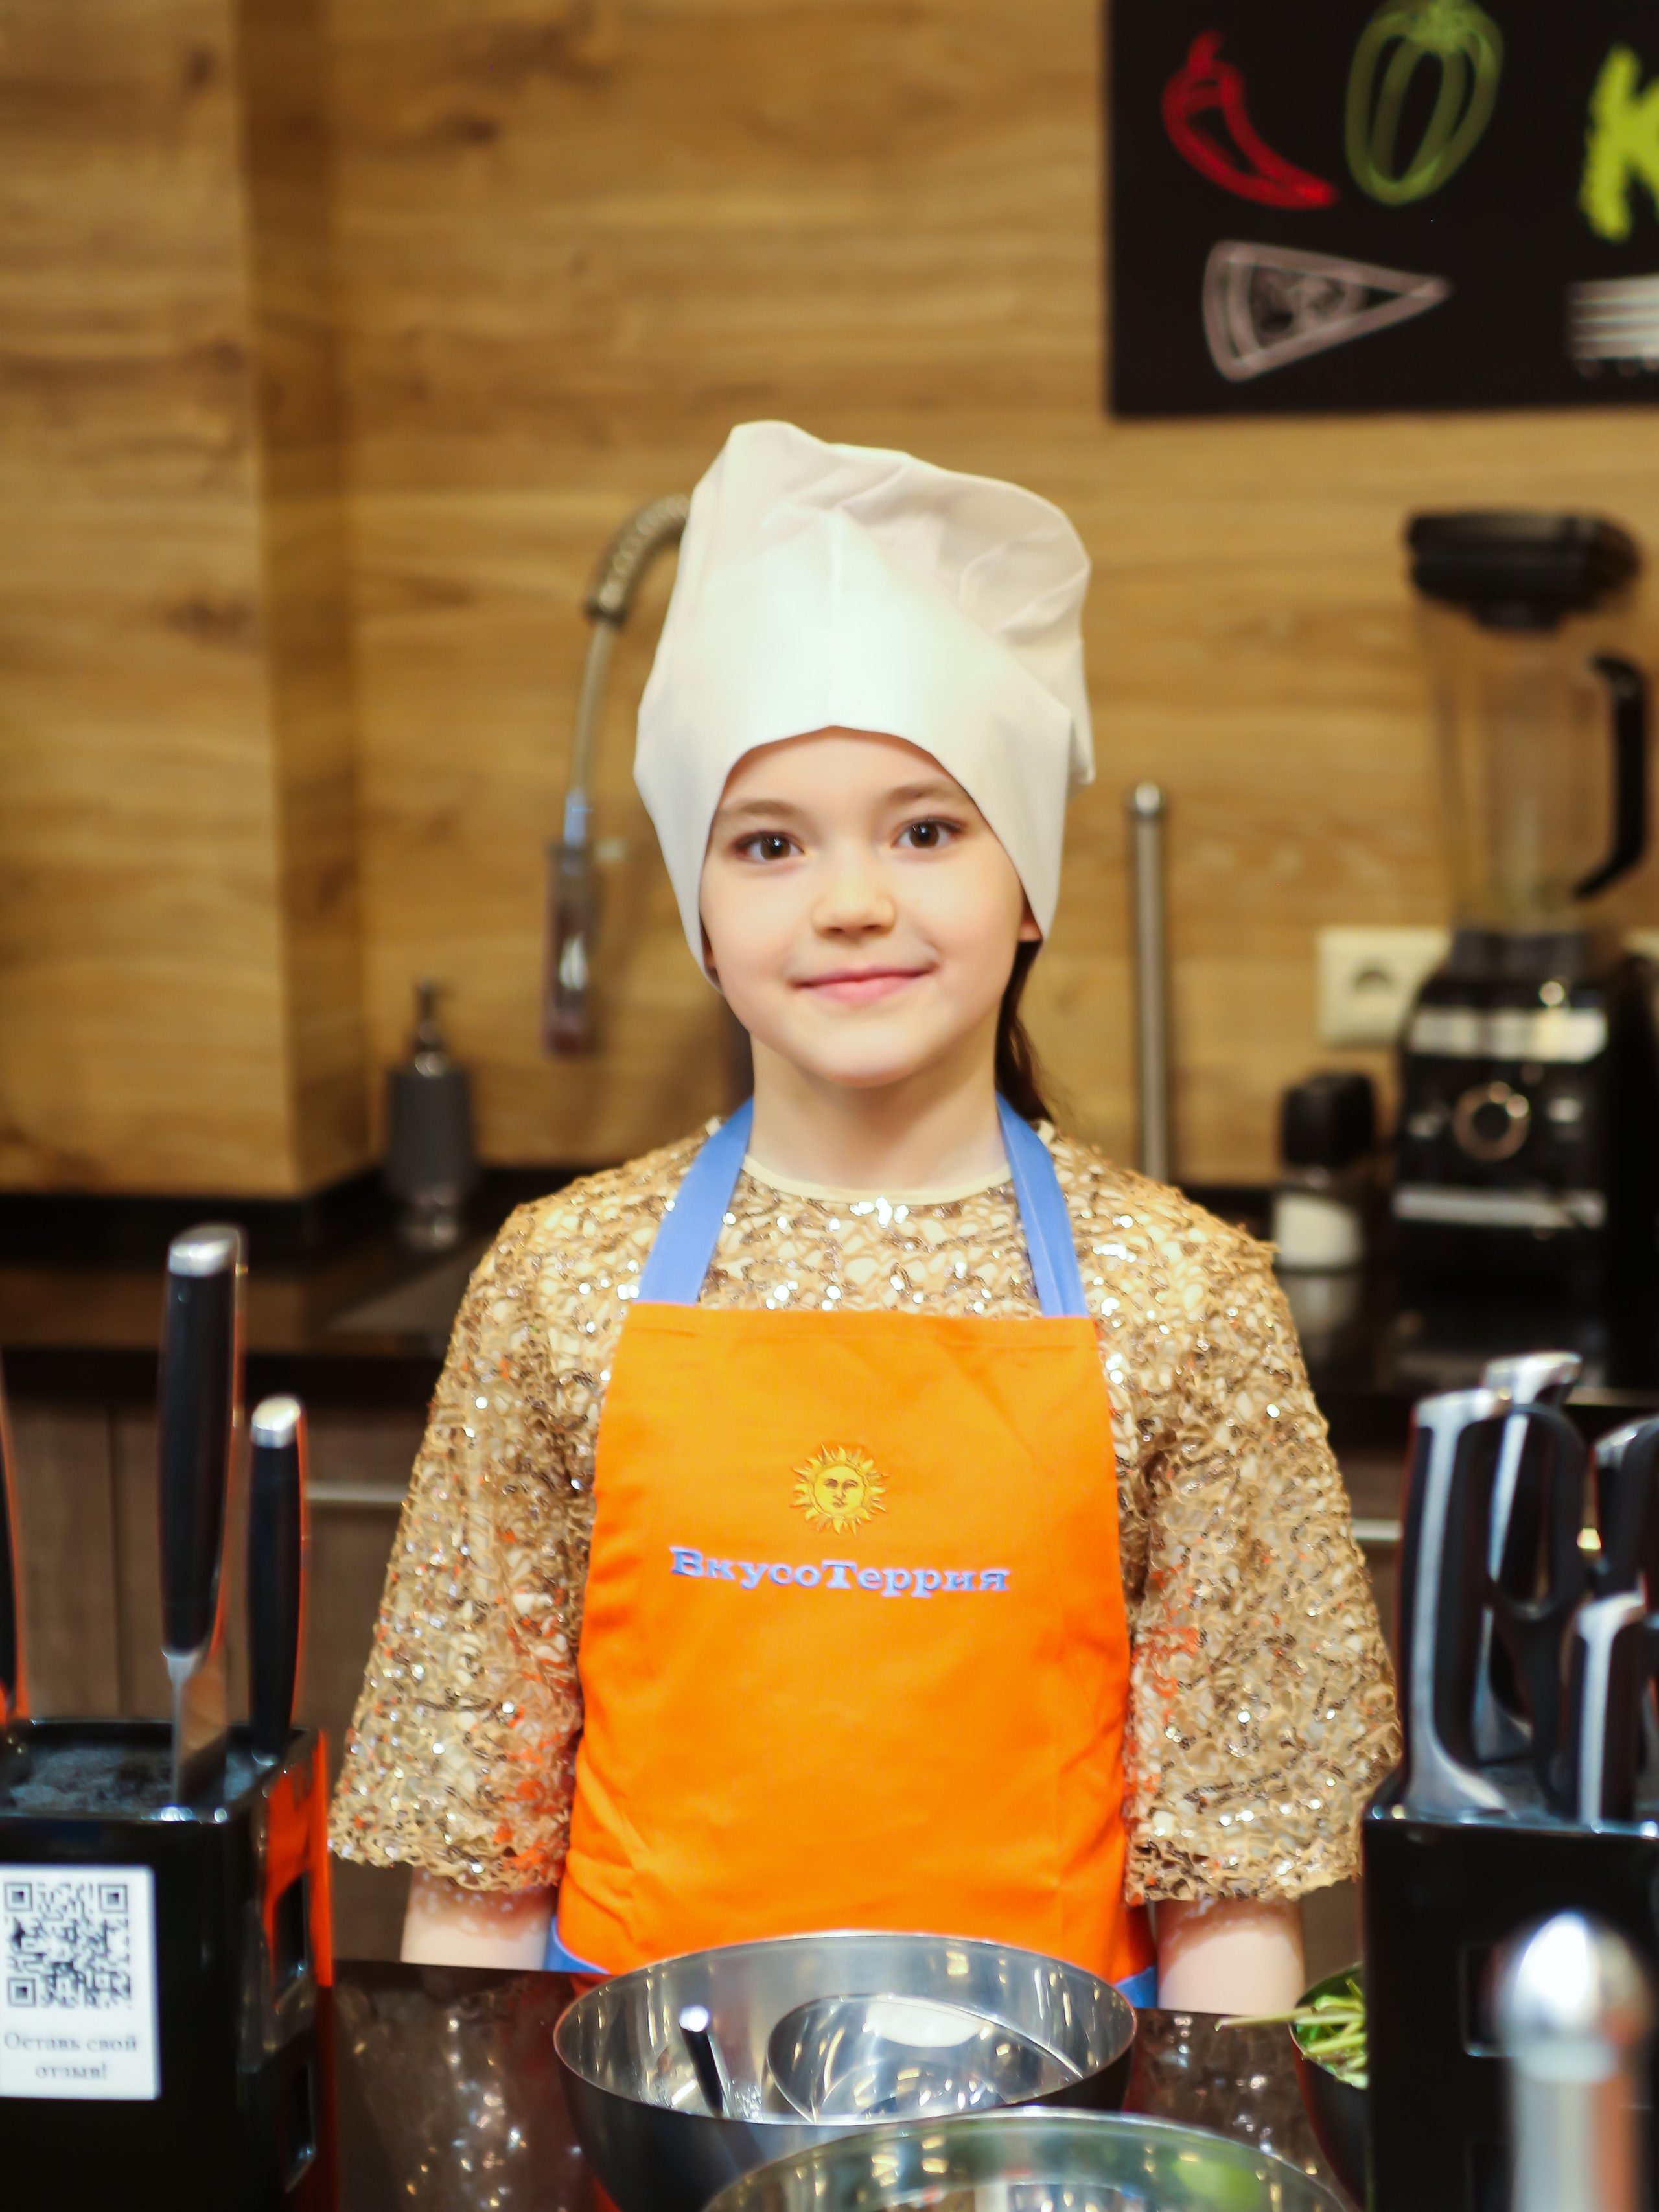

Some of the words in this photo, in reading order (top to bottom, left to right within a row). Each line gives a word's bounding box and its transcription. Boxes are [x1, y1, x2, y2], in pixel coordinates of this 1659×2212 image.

[669, 1546, 1010, 1597] ВкусоТеррия
[5, 2032, 80, 2051] Оставь
[87, 2034, 137, 2051] свой
[36, 2062, 106, 2079] отзыв!
